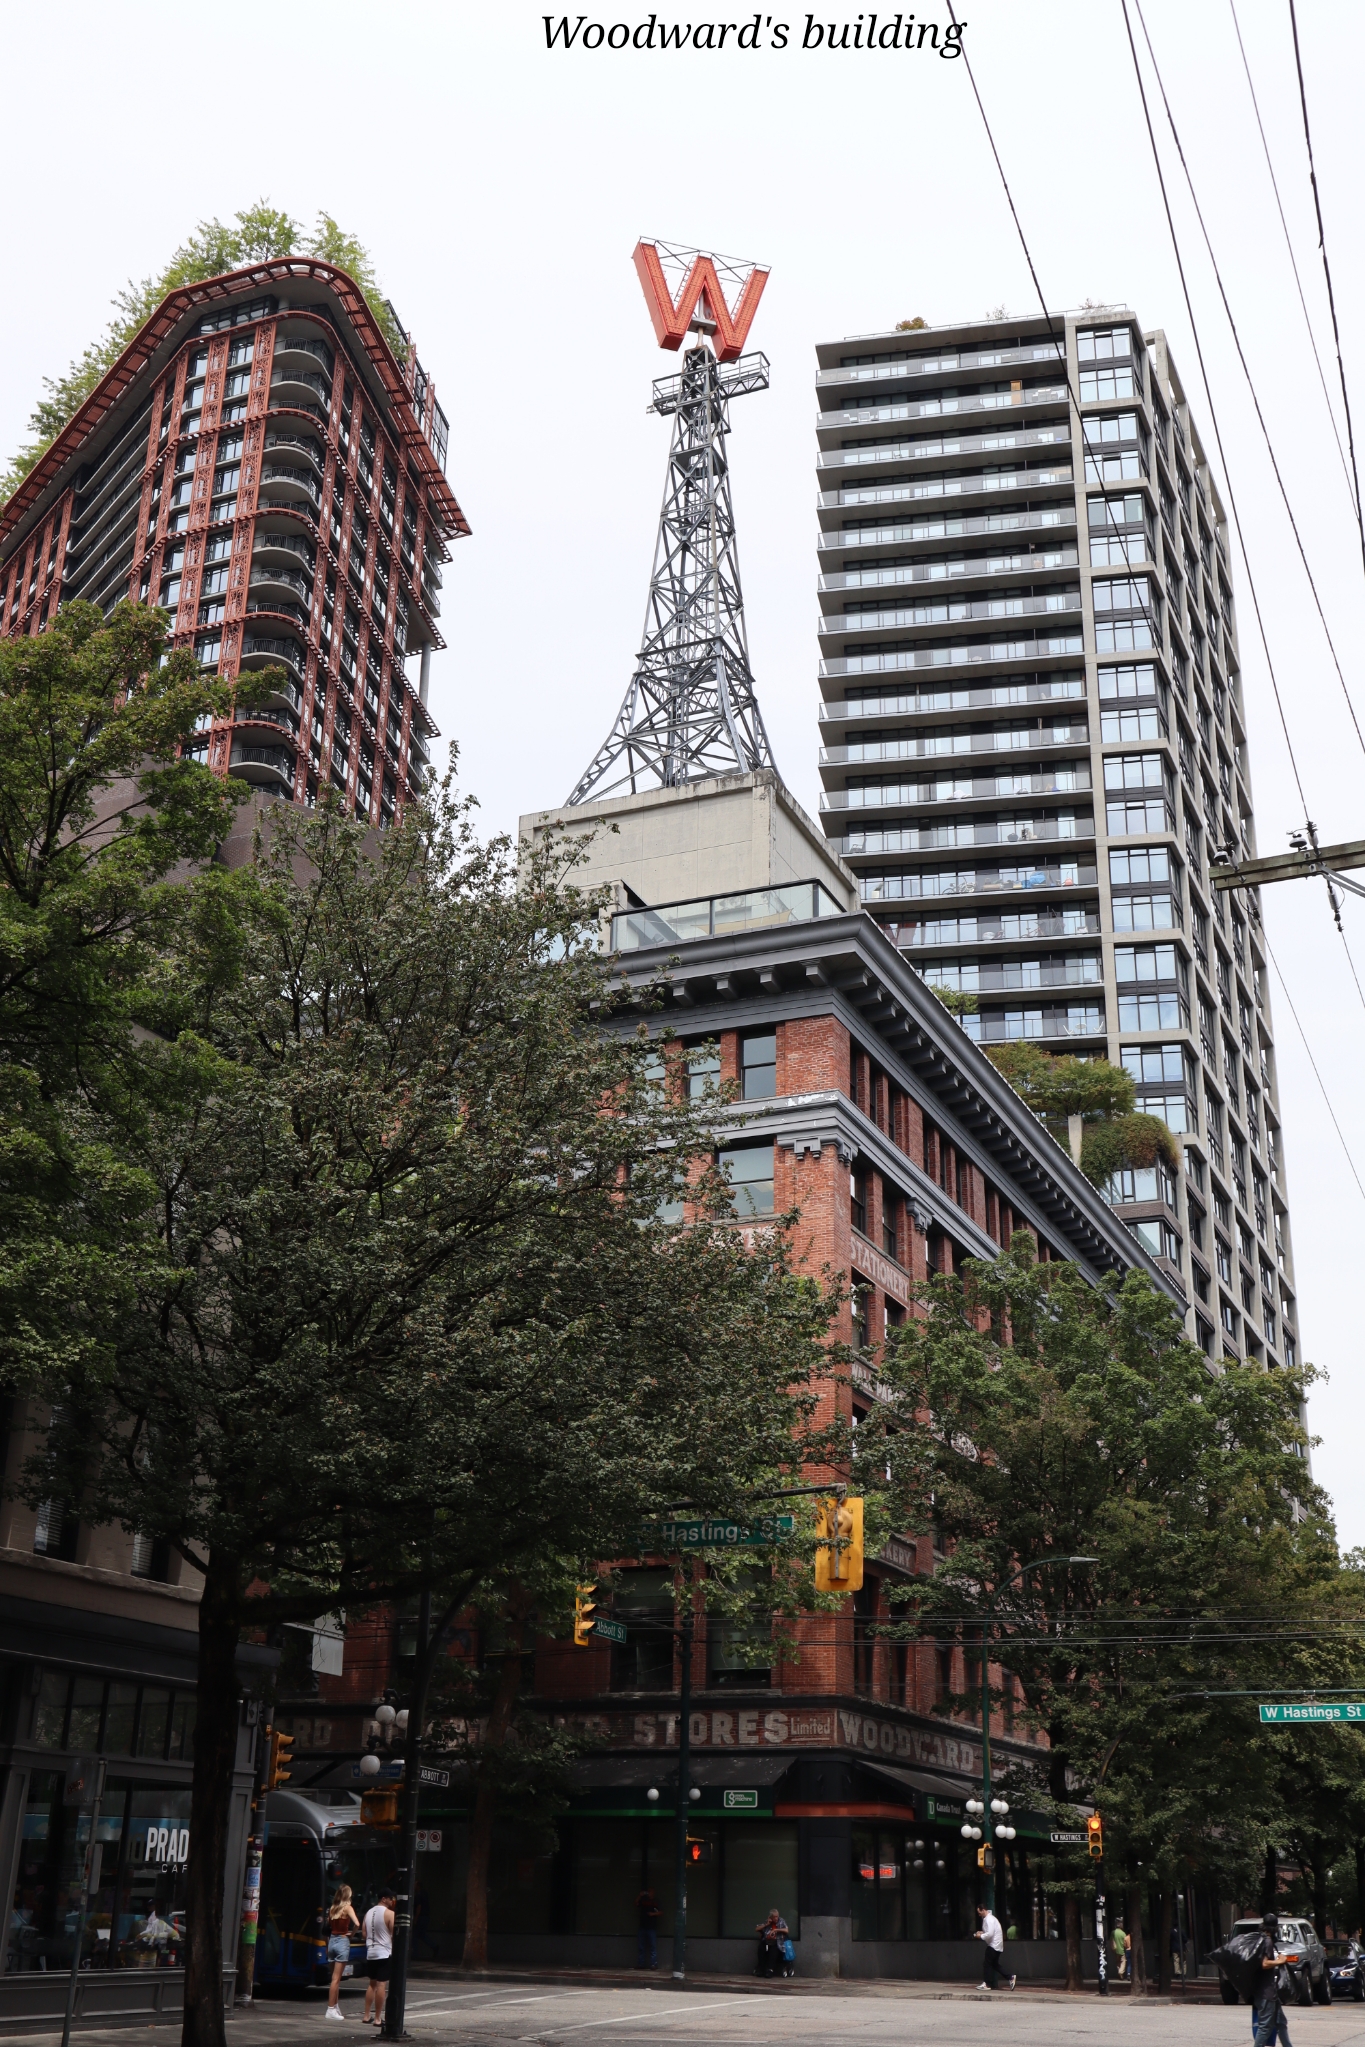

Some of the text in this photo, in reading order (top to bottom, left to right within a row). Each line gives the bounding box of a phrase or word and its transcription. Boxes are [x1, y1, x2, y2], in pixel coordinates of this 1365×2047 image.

[632, 241, 770, 364] W
[662, 1522, 750, 1544] Hastings
[596, 1621, 624, 1639] Abbott St
[1264, 1705, 1362, 1720] W Hastings St
[633, 1710, 789, 1746] STORES
[790, 1717, 831, 1736] Limited
[840, 1711, 974, 1772] WOODWARD
[420, 1769, 440, 1781] ABBOTT
[936, 1802, 951, 1813] Canada
[145, 1827, 190, 1863] PRAD
[161, 1863, 188, 1874] CAF
